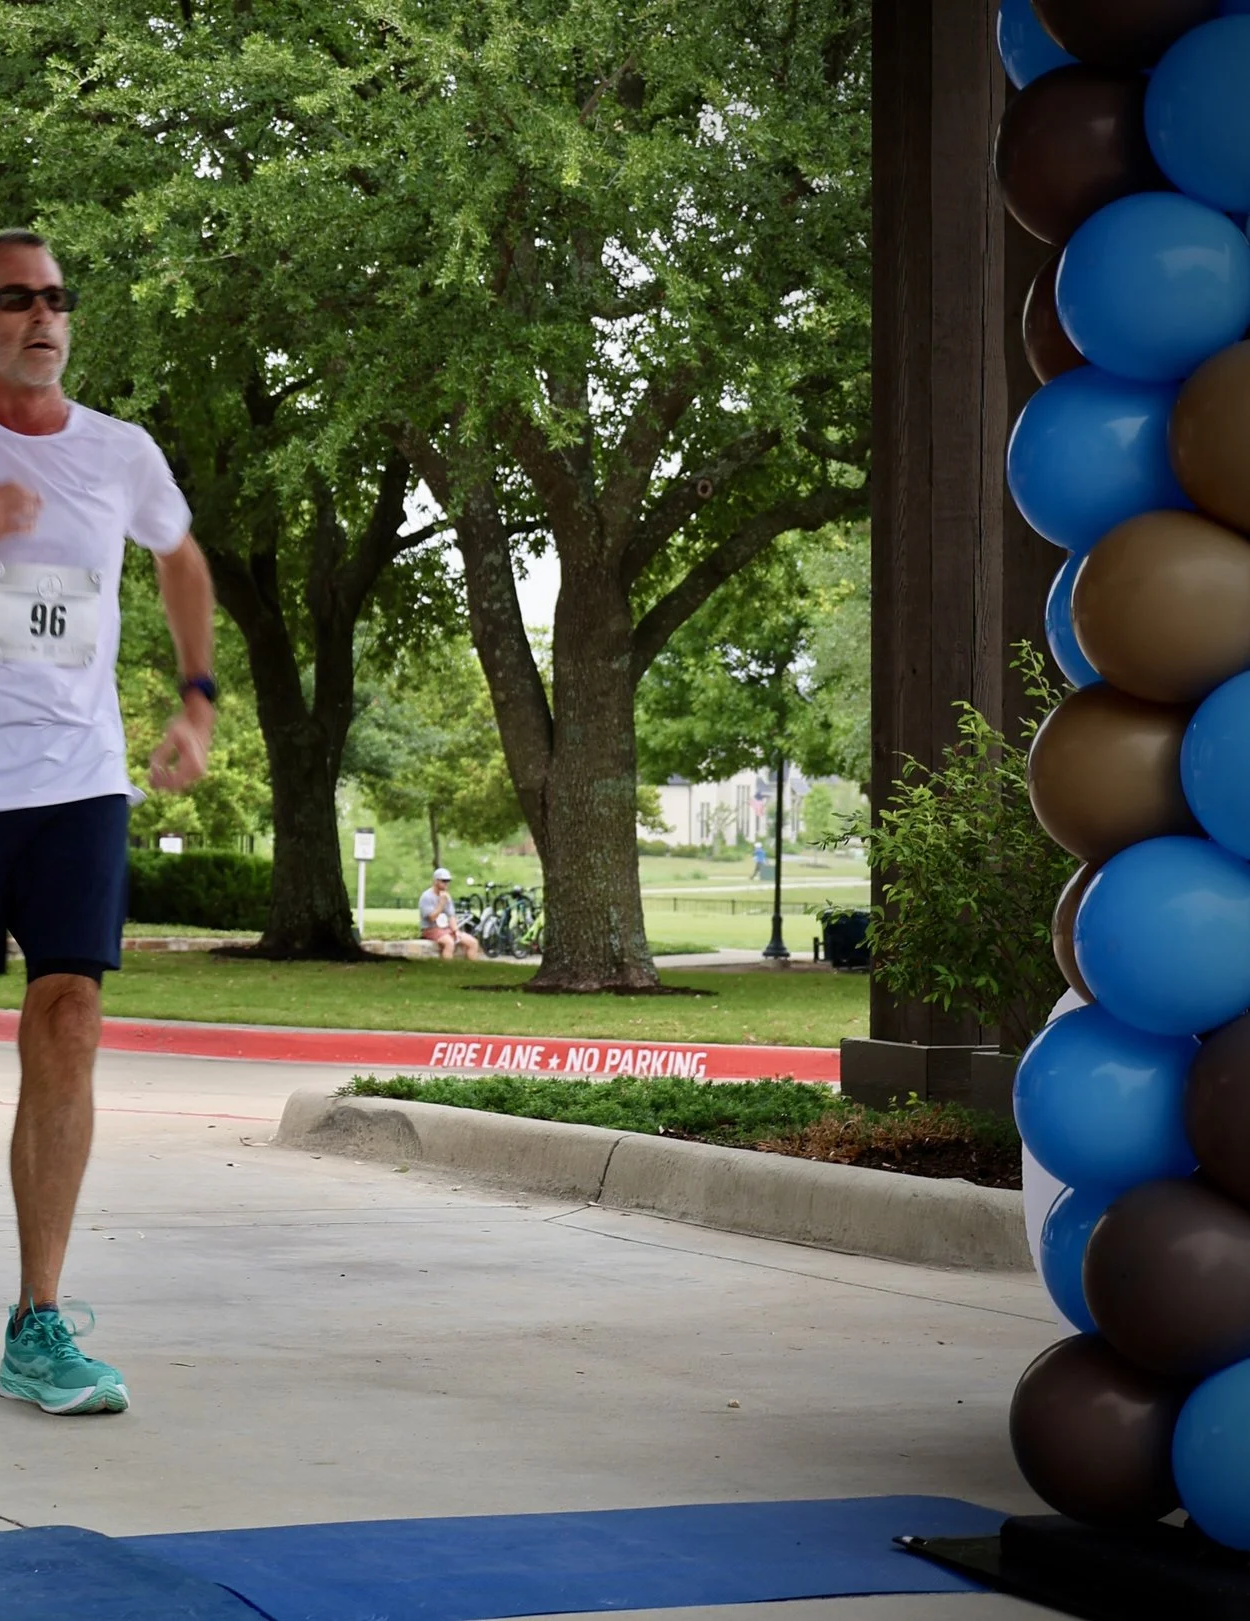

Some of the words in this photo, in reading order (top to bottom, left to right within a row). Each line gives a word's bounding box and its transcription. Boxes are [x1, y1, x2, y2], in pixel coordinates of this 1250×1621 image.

[30, 603, 67, 638] 96
[429, 1042, 481, 1067] FIRE
[482, 1044, 545, 1070] LANE
[563, 1047, 600, 1073] NO
[603, 1049, 707, 1077] PARKING
